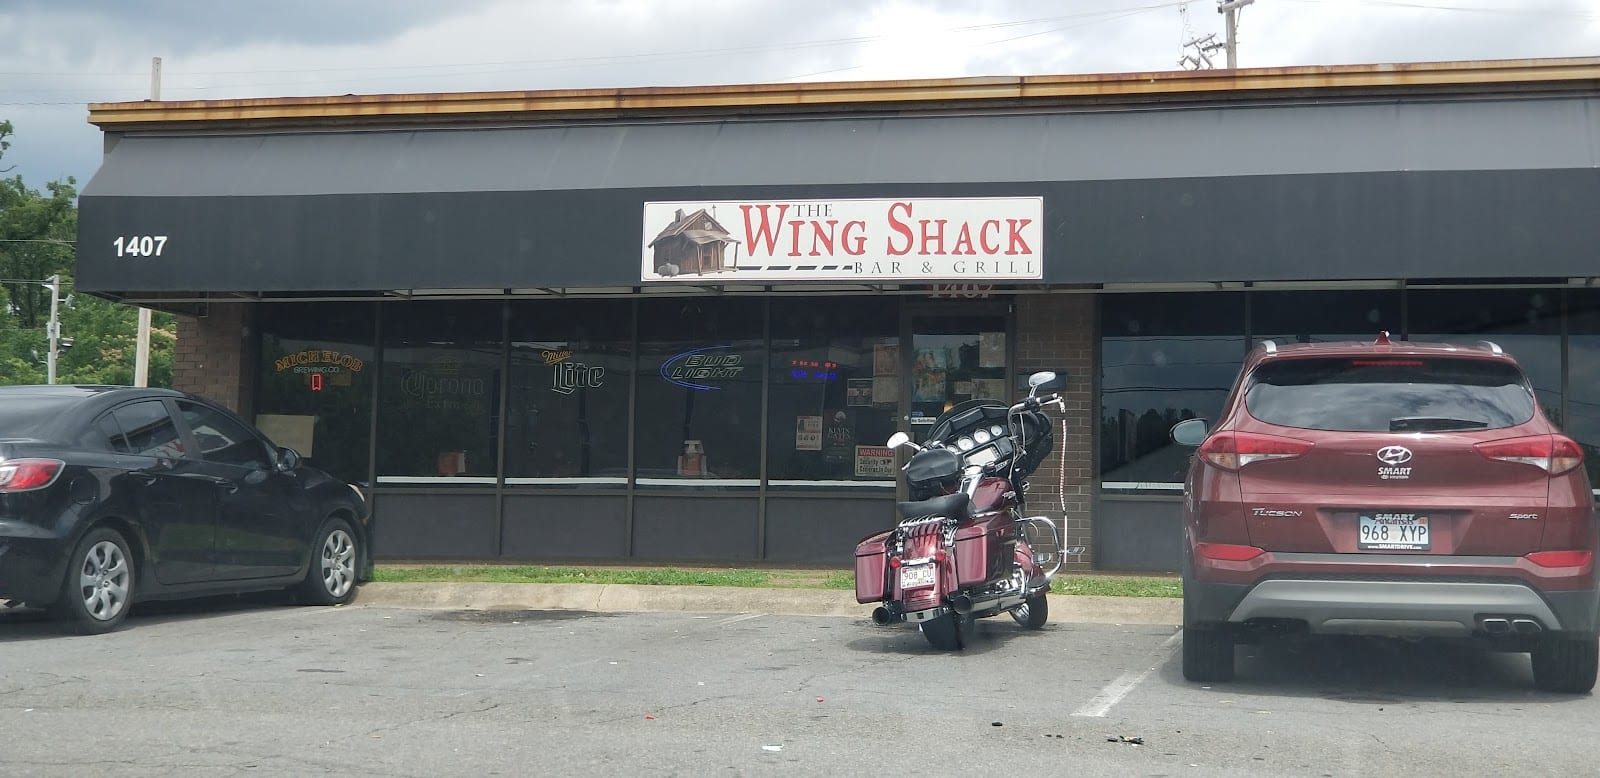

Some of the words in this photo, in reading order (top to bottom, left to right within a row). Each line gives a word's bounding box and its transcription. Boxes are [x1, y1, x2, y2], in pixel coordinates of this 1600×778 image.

[792, 203, 833, 217] THE
[738, 203, 868, 257] WING
[886, 202, 1033, 256] SHACK
[113, 235, 168, 257] 1407
[854, 261, 902, 274] BAR
[921, 261, 934, 274] &
[953, 260, 1036, 274] GRILL
[274, 350, 363, 372] MICHELOB
[685, 355, 741, 366] BUD
[551, 362, 605, 395] Lite
[671, 366, 744, 379] LIGHT
[401, 369, 486, 400] Corona
[859, 448, 895, 457] WARNING
[1377, 467, 1412, 476] SMART
[1251, 507, 1303, 517] TUCSON
[1374, 513, 1416, 521] SMART
[1361, 525, 1389, 541] 968
[1399, 525, 1427, 542] XYP
